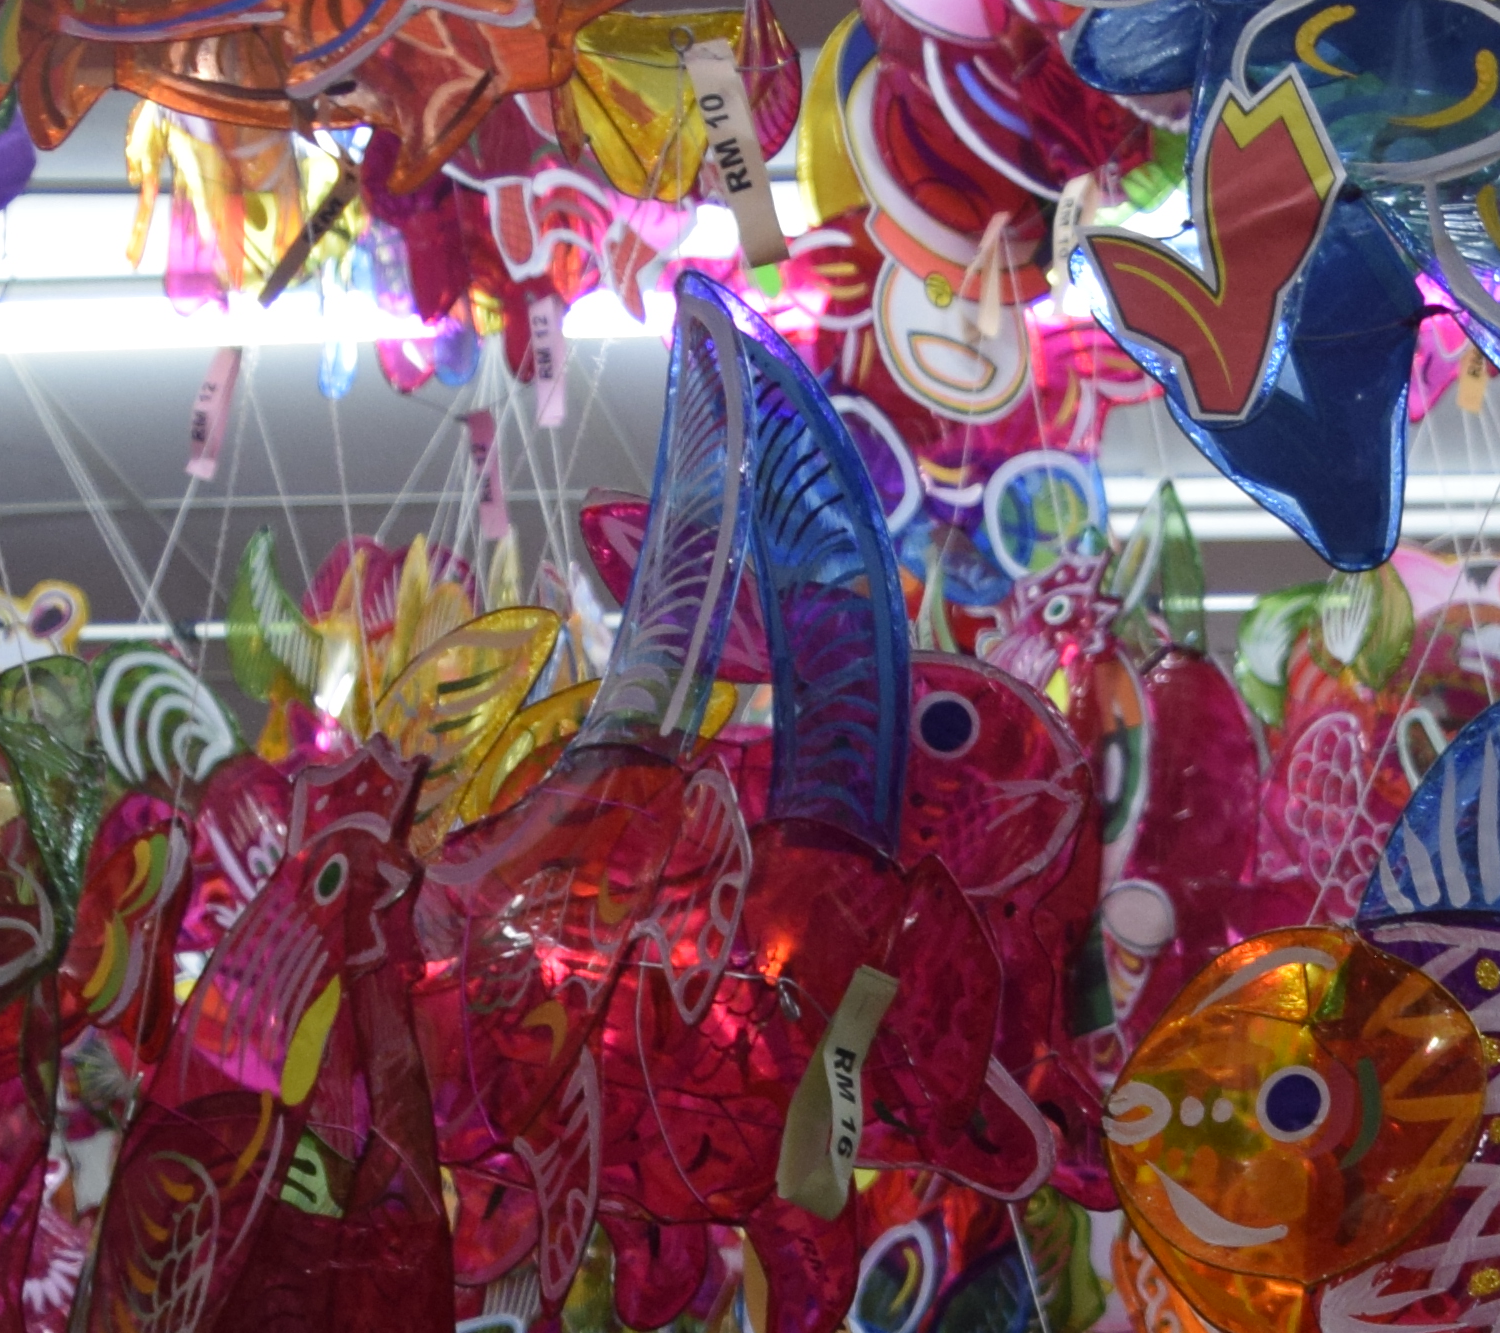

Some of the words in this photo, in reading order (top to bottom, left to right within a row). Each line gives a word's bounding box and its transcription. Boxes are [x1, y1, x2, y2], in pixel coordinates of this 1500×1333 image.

[700, 93, 728, 128] 10
[718, 139, 752, 193] RM
[1062, 197, 1077, 225] RM
[533, 315, 549, 339] 12
[537, 346, 553, 381] RM
[199, 382, 217, 405] 12
[192, 411, 207, 443] RM
[832, 1046, 861, 1103] RM
[834, 1110, 857, 1160] 16
